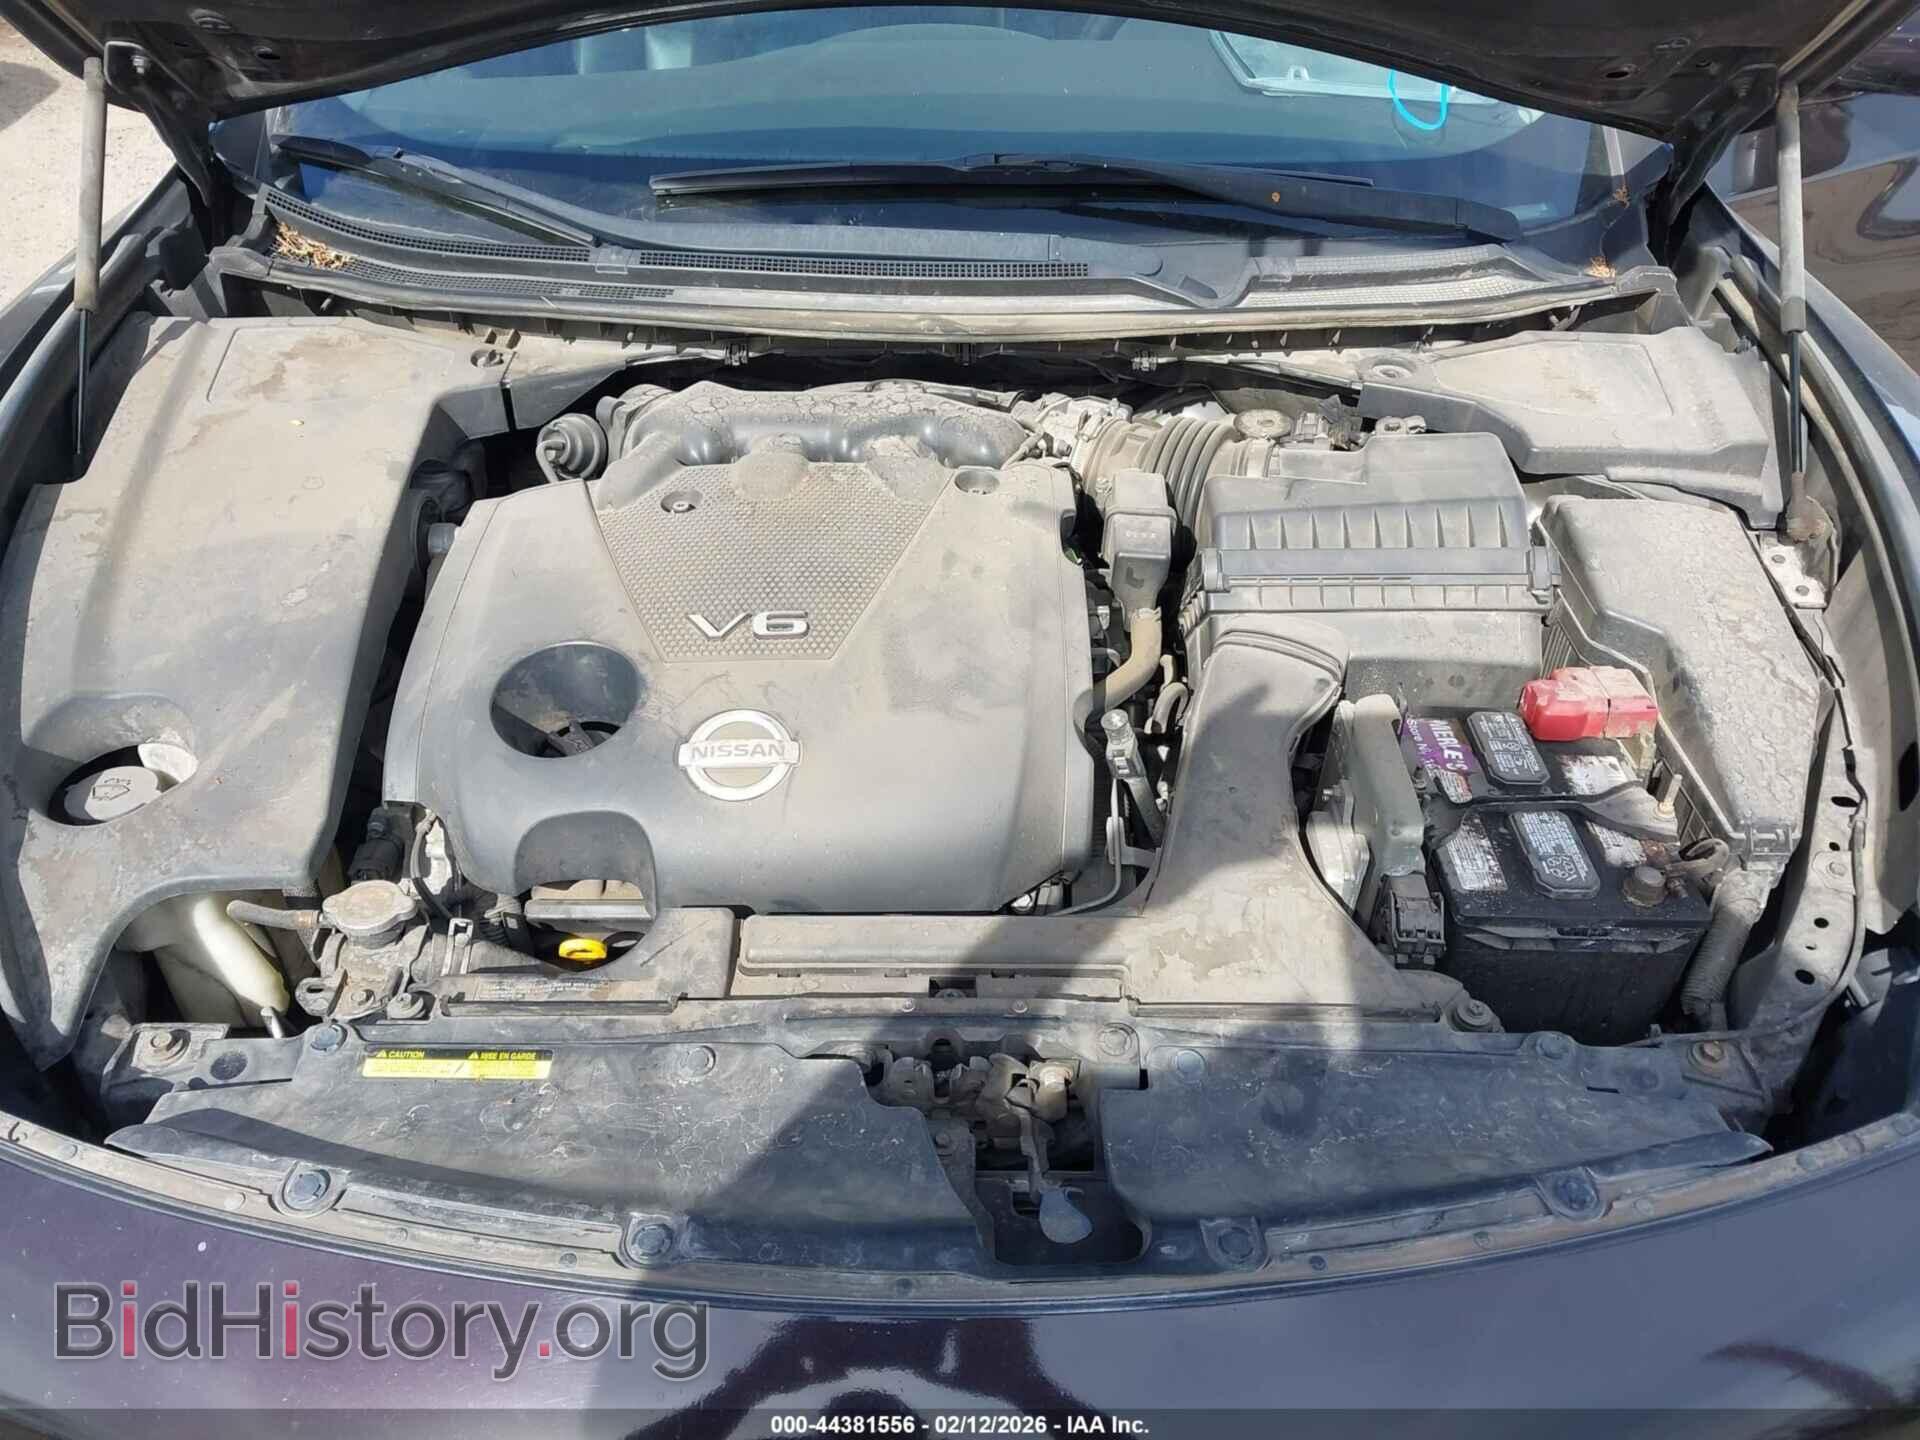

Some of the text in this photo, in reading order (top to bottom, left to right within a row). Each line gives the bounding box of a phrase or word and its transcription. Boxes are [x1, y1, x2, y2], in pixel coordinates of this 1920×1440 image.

[687, 610, 810, 641] V6
[691, 742, 786, 760] NISSAN
[1428, 718, 1469, 771] MERLE'S
[388, 1050, 425, 1058] CAUTION
